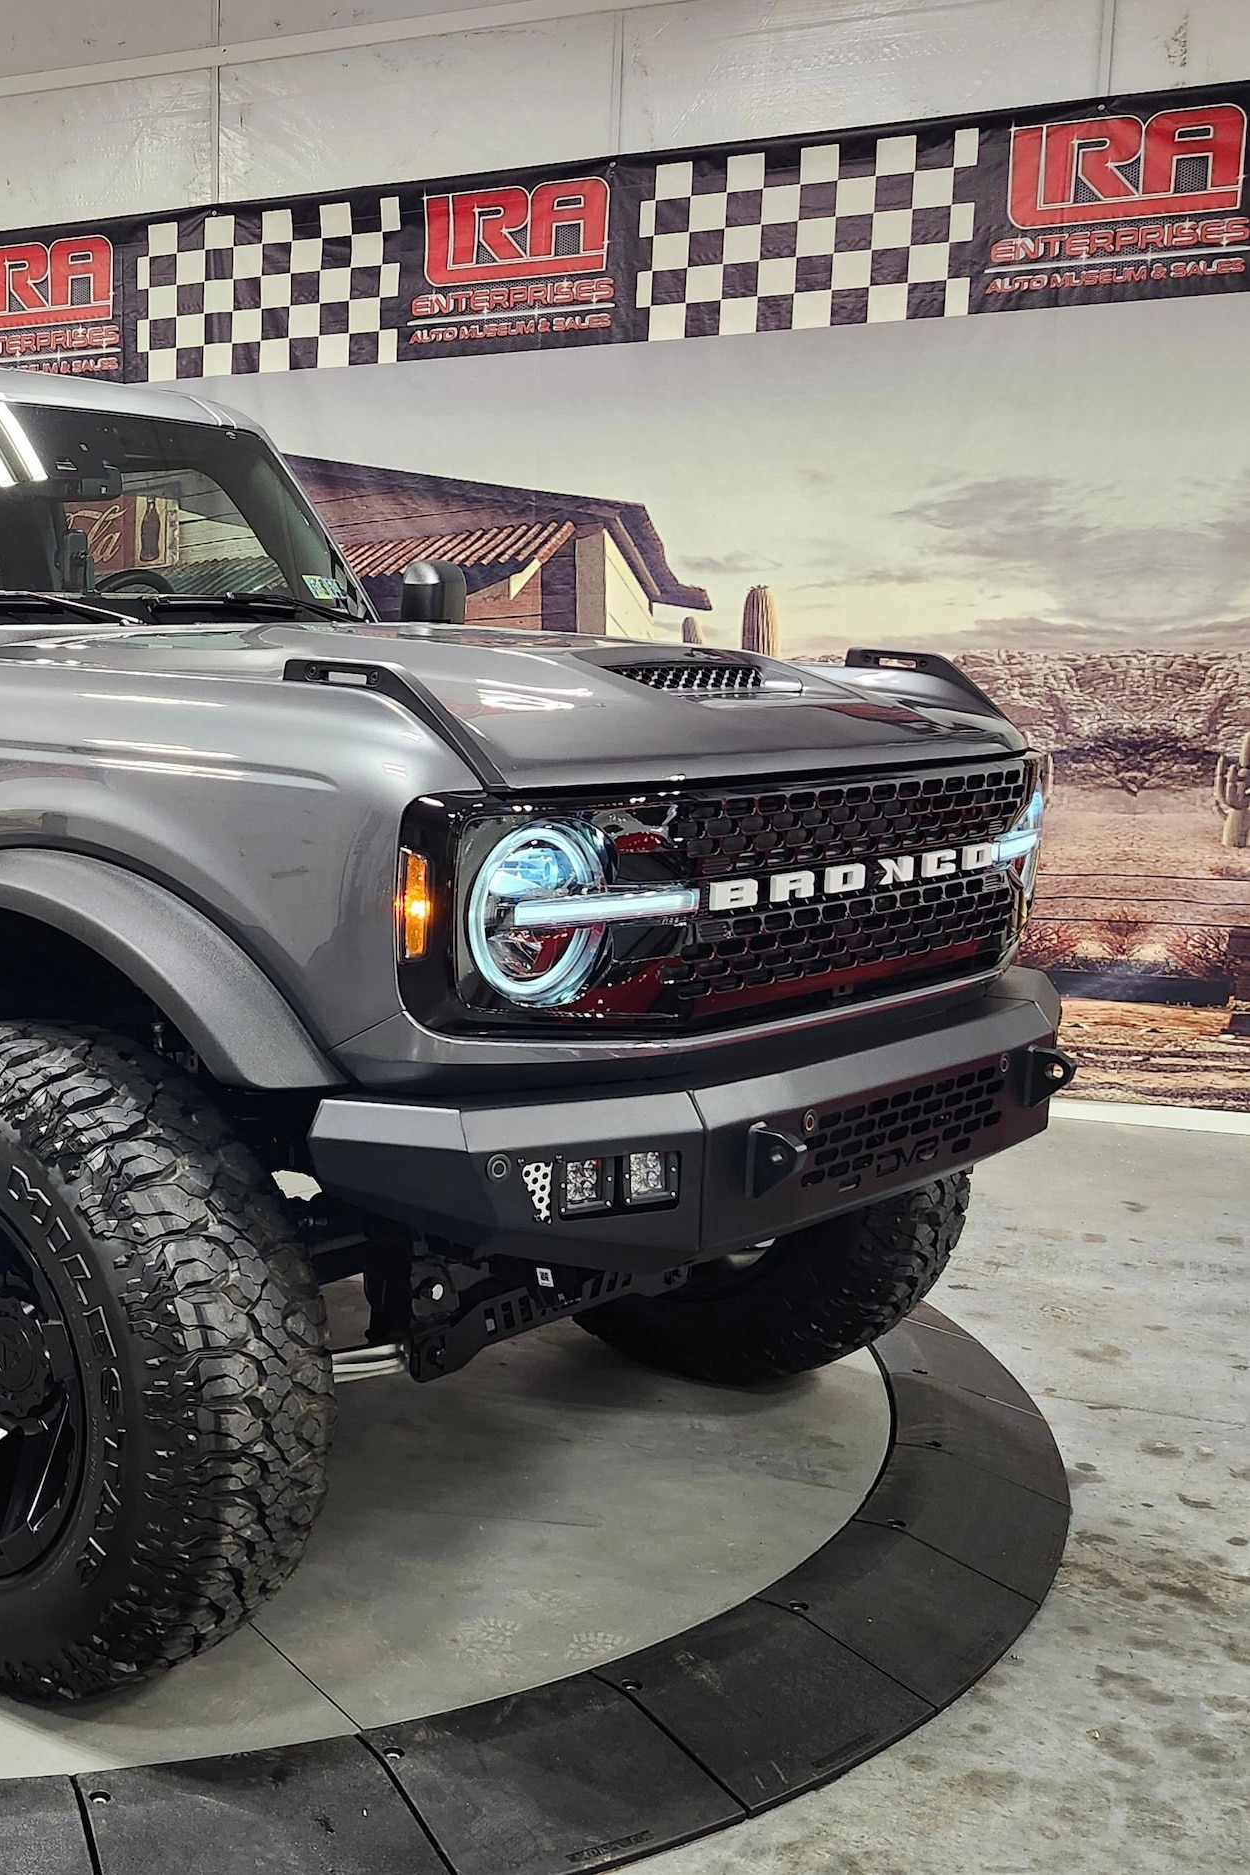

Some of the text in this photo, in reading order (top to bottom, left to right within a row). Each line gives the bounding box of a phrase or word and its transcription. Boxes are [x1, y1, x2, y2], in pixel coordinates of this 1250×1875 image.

[990, 217, 1250, 264] ENTERPRISES
[986, 257, 1246, 294] AUTO MUSEUM & SALES
[411, 277, 615, 317] ENTERPRISES
[409, 313, 612, 344] AUTO MUSEUM & SALES
[60, 361, 70, 374] &
[72, 357, 119, 373] SALES
[708, 842, 993, 912] BRONCO
[7, 1165, 125, 1586] MILESTAR
